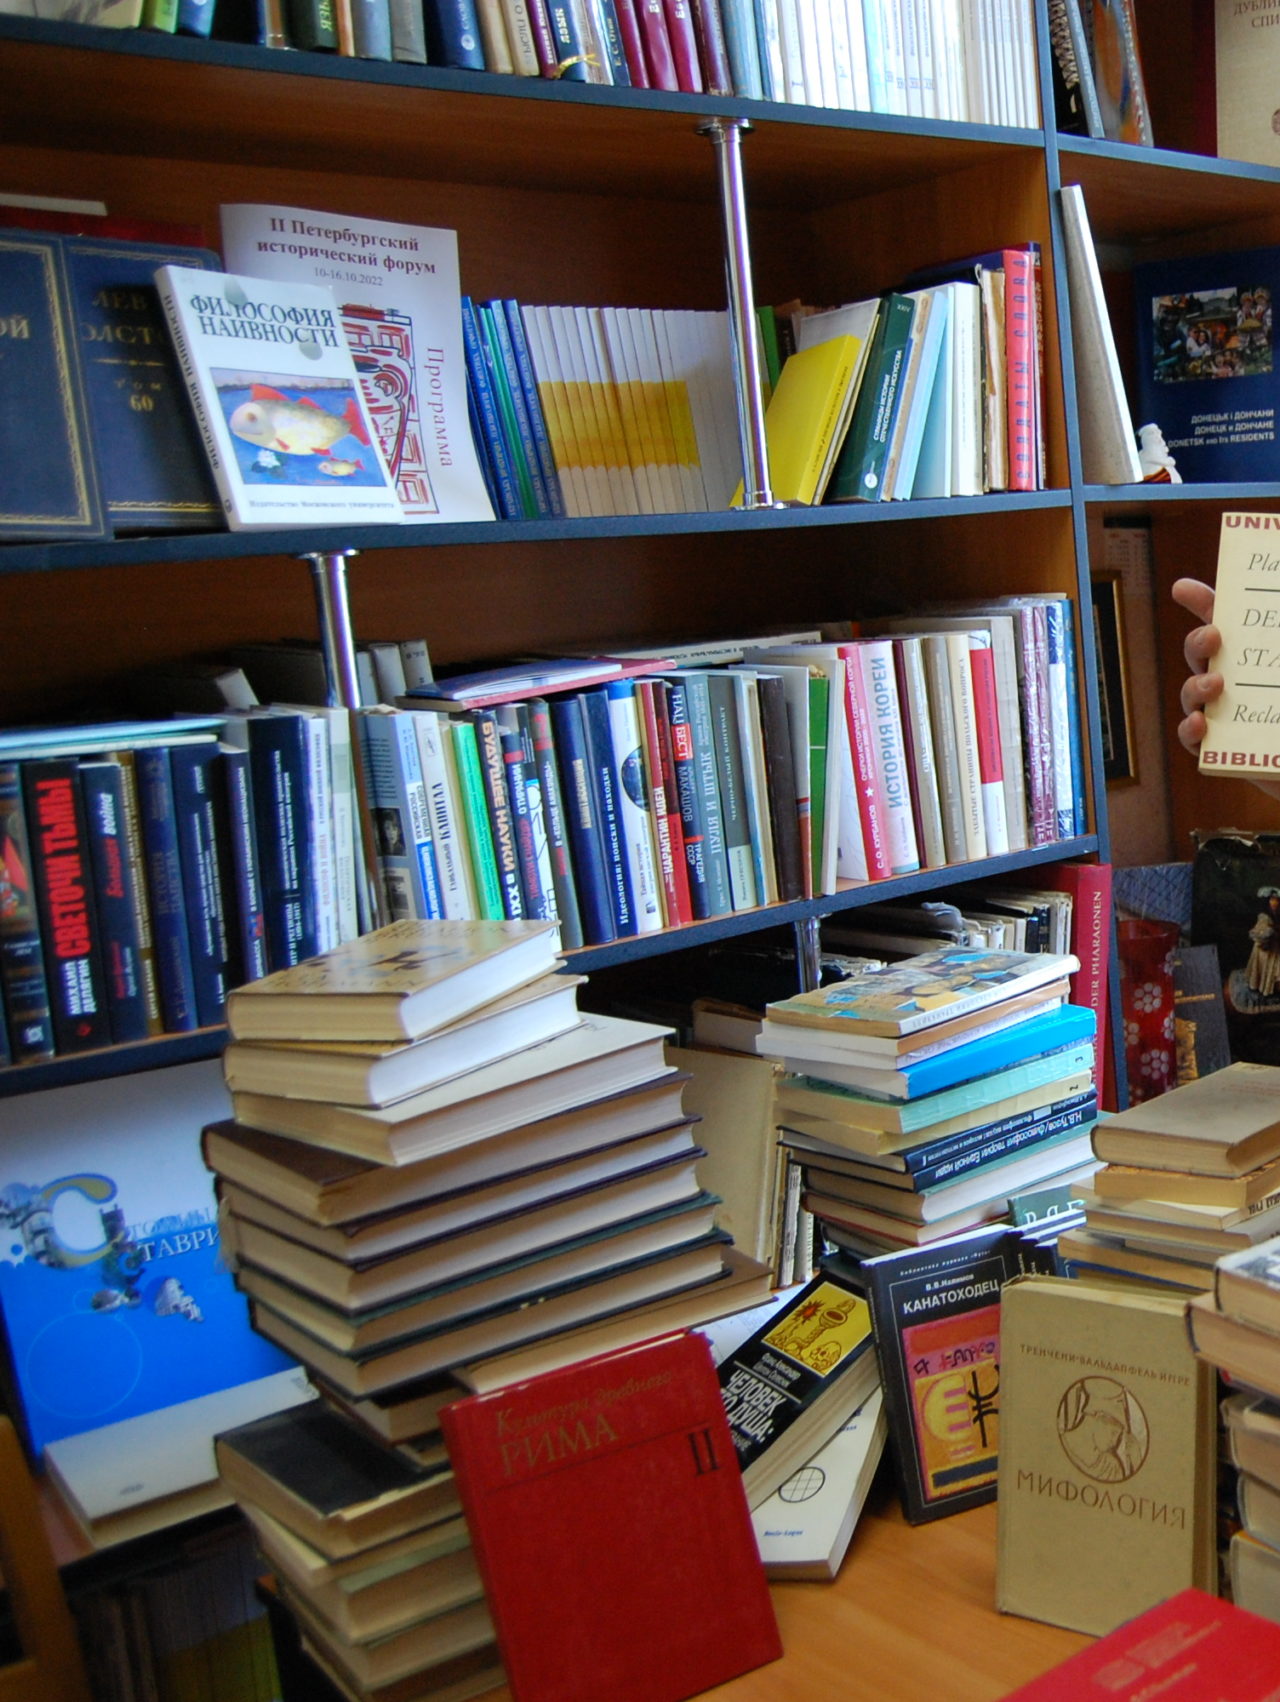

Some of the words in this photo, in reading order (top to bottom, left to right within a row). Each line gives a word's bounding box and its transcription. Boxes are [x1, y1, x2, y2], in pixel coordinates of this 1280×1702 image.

[554, 7, 570, 44] ЯЗЫК
[271, 218, 285, 231] II
[291, 221, 419, 251] Петербургский
[257, 240, 378, 266] исторический
[383, 258, 436, 276] форум
[314, 267, 383, 286] 10-16.10.2022
[190, 294, 336, 328] ФИЛОСОФИЯ
[200, 317, 341, 348] НАИВНОСТИ
[161, 294, 195, 376] НАИВНОСТИ
[130, 395, 154, 412] 60
[187, 382, 222, 469] ФИЛОСОФИЯ
[425, 348, 453, 467] Программа
[1191, 412, 1229, 424] ДОНЕЦЬК
[1234, 409, 1274, 421] ДОНЧАНИ
[1194, 423, 1227, 435] ДОНЕЦК
[1234, 420, 1274, 431] ДОНЧАНЕ
[1230, 431, 1275, 443] RESIDENTS
[669, 693, 686, 724] НАЦ
[870, 657, 891, 718] КОРЕИ
[673, 725, 690, 757] БЕСТ
[697, 751, 718, 795] ШТЫК
[878, 723, 902, 808] ИСТОРИЯ
[481, 720, 506, 808] БУДУЩЕЕ
[495, 808, 515, 871] НАУКИ
[601, 766, 614, 811] находки
[676, 765, 694, 822] МАКАШОВ
[705, 800, 717, 811] И
[35, 777, 78, 854] ТЬМЫ
[97, 791, 116, 835] война
[430, 782, 452, 840] КАПИТАЛ
[867, 804, 881, 848] КУРБАНОВ
[609, 823, 620, 861] поиски
[656, 817, 674, 873] КАРАНТИН
[705, 815, 724, 853] ПУЛЯ
[45, 853, 91, 958] СВЕТОЧИ
[612, 863, 629, 923] Идеология:
[1090, 890, 1103, 975] PHARAONEN
[62, 961, 83, 1014] МИХАИЛ
[75, 958, 97, 1013] ДЕЛЯГИН
[1090, 980, 1099, 1007] DER
[979, 1139, 1006, 1158] теории
[903, 1279, 999, 1315] КАНАТОХОДЕЦ
[925, 1273, 974, 1291] В.В.Налимов
[728, 1369, 787, 1418] ЧЕЛОВЕК
[495, 1399, 591, 1438] Культура
[727, 1398, 775, 1443] ДУША:
[500, 1420, 619, 1479] РИМА
[687, 1431, 722, 1477] II
[1017, 1469, 1187, 1530] МИФОЛОГИЯ
